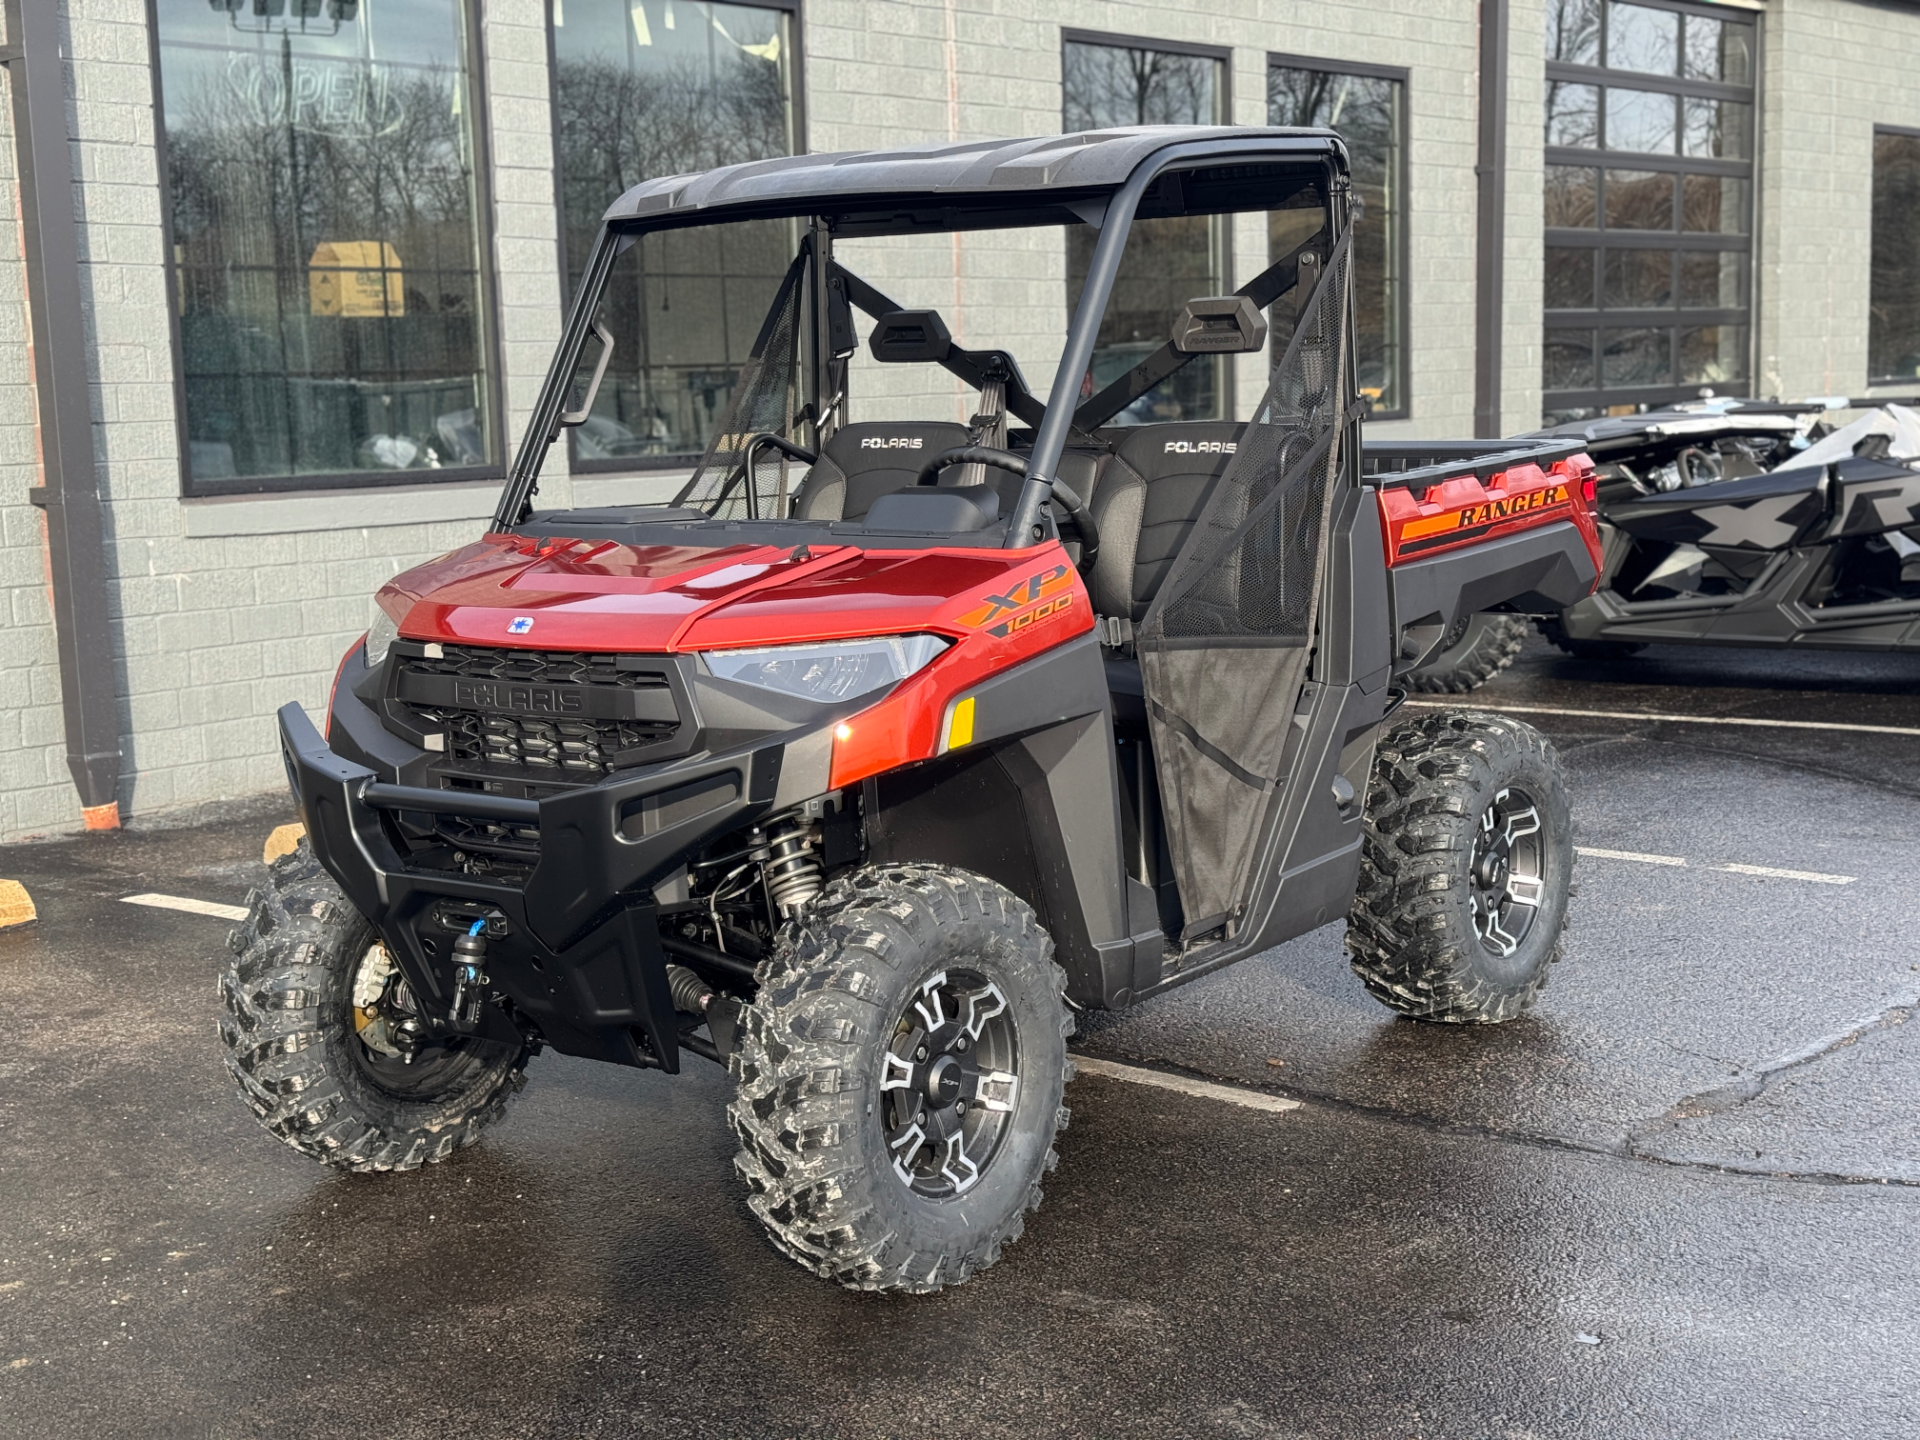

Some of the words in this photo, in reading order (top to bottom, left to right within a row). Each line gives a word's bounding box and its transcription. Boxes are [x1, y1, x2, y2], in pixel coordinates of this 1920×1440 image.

[246, 62, 389, 126] OPEN
[1189, 336, 1240, 345] RANGER
[861, 437, 923, 449] POLARIS
[1165, 441, 1237, 454] POLARIS
[1458, 486, 1559, 529] RANGER
[978, 564, 1067, 626] XP
[1007, 592, 1073, 633] 1000
[455, 681, 583, 712] POLARIS
